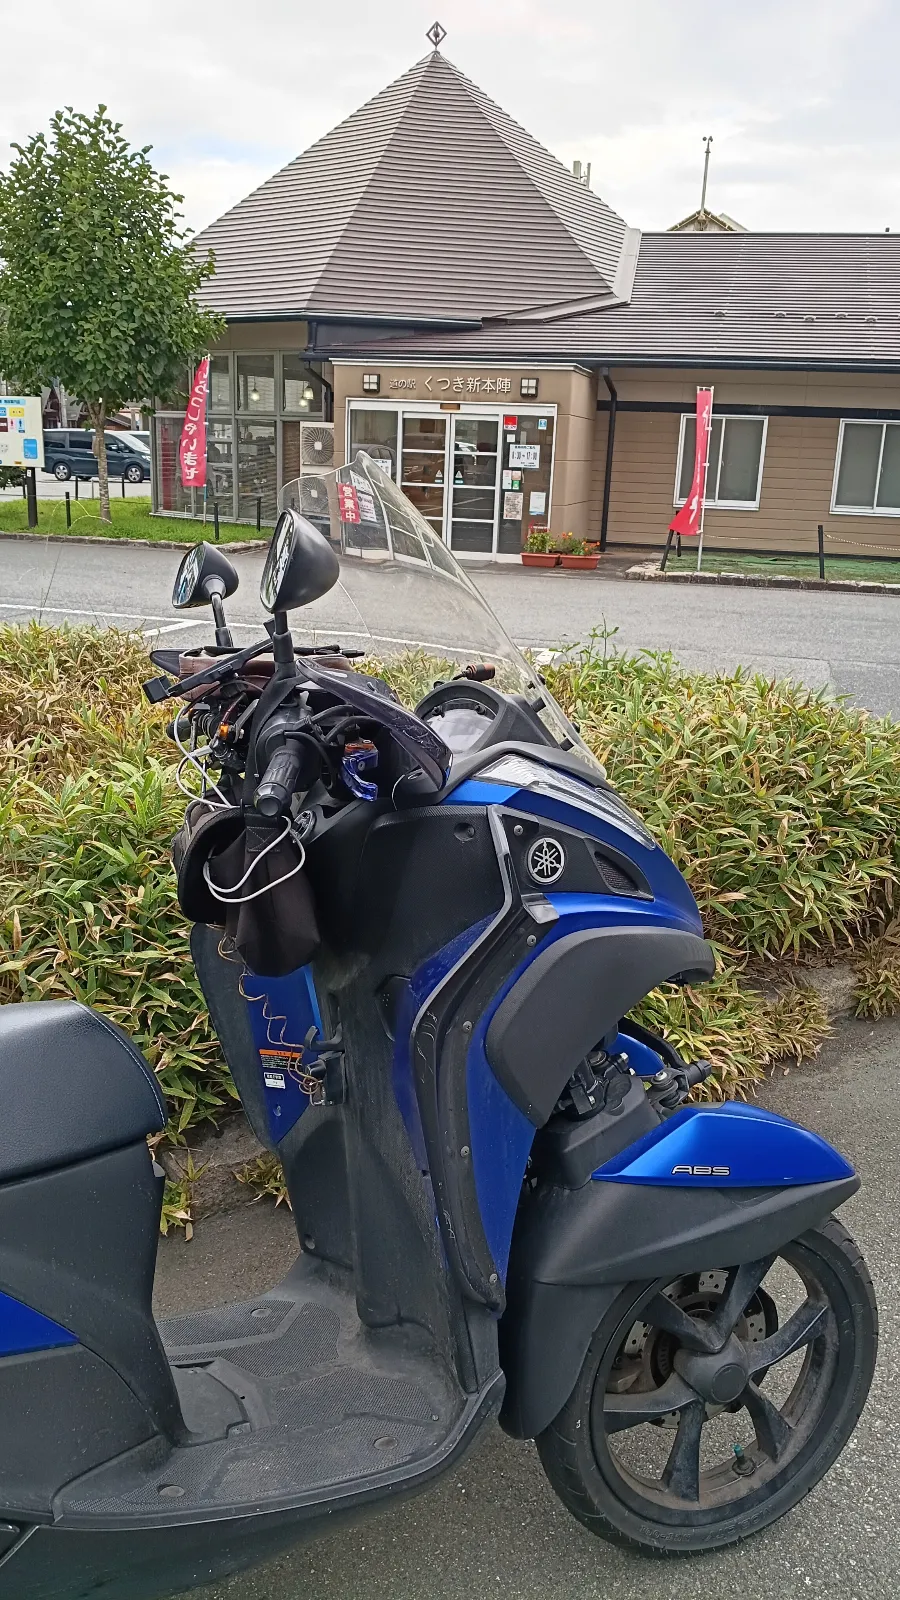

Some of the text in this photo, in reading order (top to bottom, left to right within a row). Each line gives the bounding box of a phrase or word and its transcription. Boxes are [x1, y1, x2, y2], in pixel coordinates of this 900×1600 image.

[389, 375, 511, 393] 道の駅 くつき新本陣
[342, 485, 356, 522] 営業中
[671, 1165, 730, 1176] ABS
